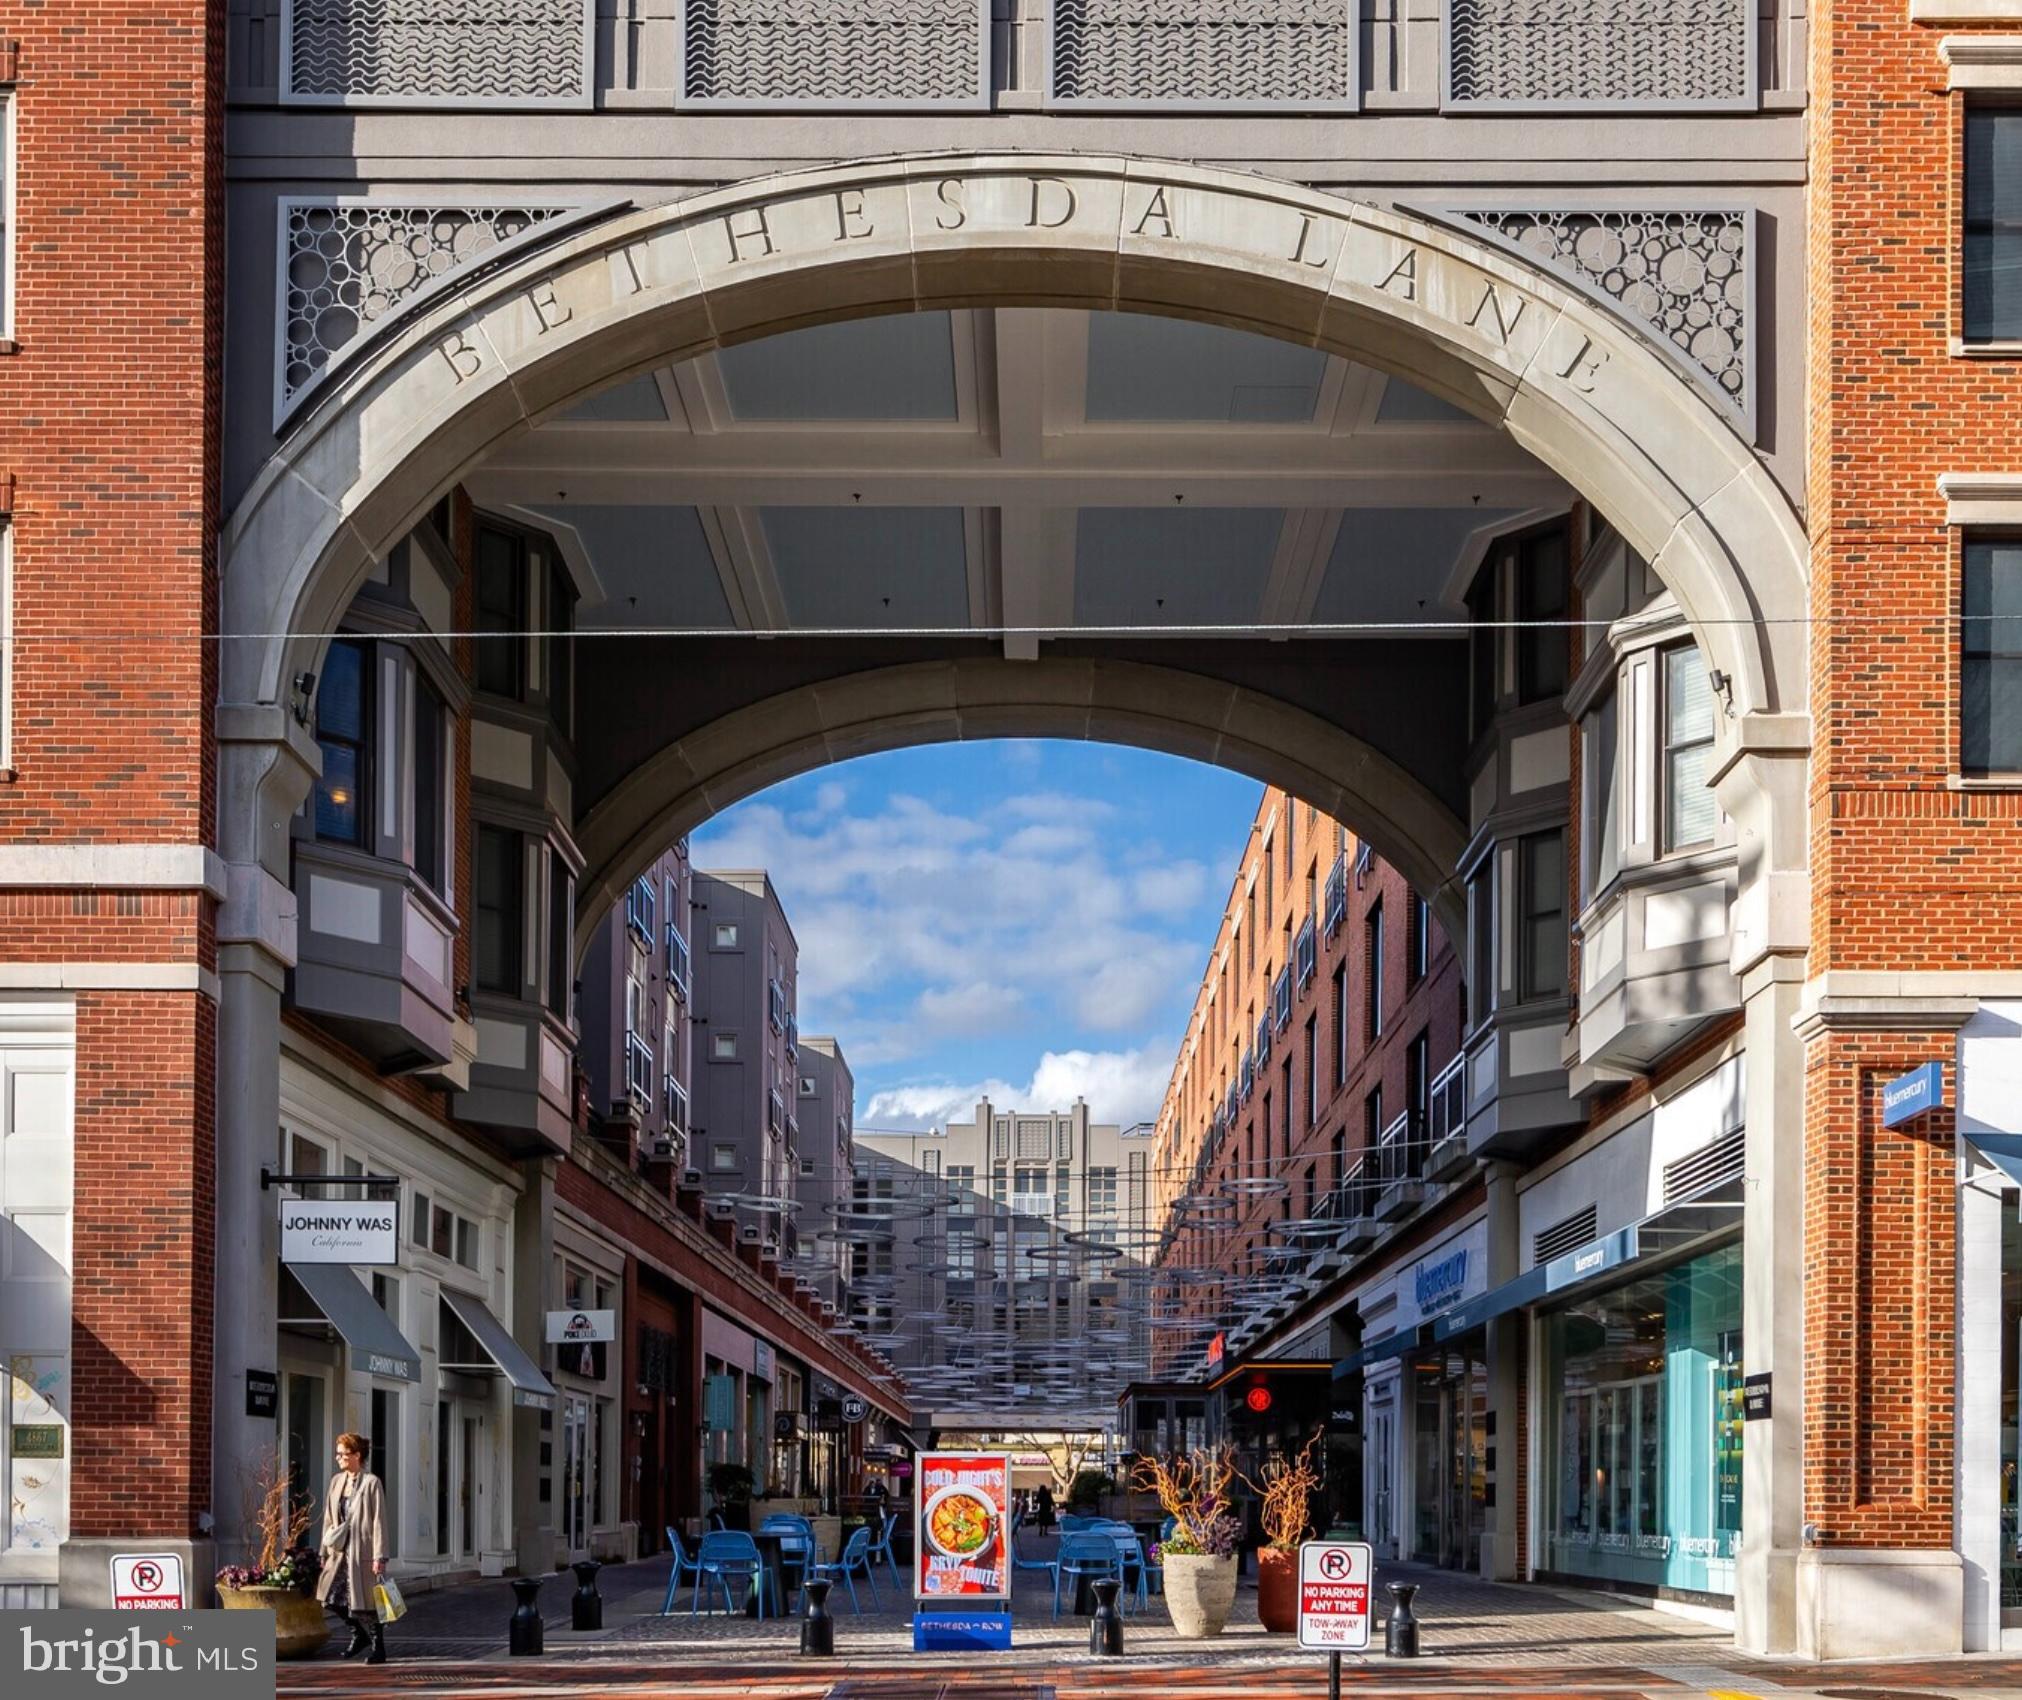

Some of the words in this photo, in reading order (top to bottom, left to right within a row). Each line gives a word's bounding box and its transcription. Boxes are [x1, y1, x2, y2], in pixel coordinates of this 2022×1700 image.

[430, 177, 1180, 386] BETHESDA
[1287, 212, 1611, 395] LANE
[1884, 1077, 1928, 1110] bluemercury
[285, 1216, 352, 1231] JOHNNY
[355, 1217, 393, 1232] WAS
[311, 1234, 363, 1251] California
[368, 1354, 393, 1373] JOHNNY
[394, 1361, 409, 1378] WAS
[1304, 1586, 1319, 1598] NO
[1320, 1587, 1365, 1599] PARKING
[118, 1600, 132, 1609] NO
[134, 1599, 179, 1609] PARKING
[1310, 1600, 1334, 1611] ANY
[1335, 1600, 1358, 1612] TIME
[921, 1621, 971, 1631] BETHESDA
[982, 1621, 1004, 1631] ROW
[1309, 1618, 1359, 1629] TOW-AWAY
[1321, 1630, 1346, 1641] ZONE
